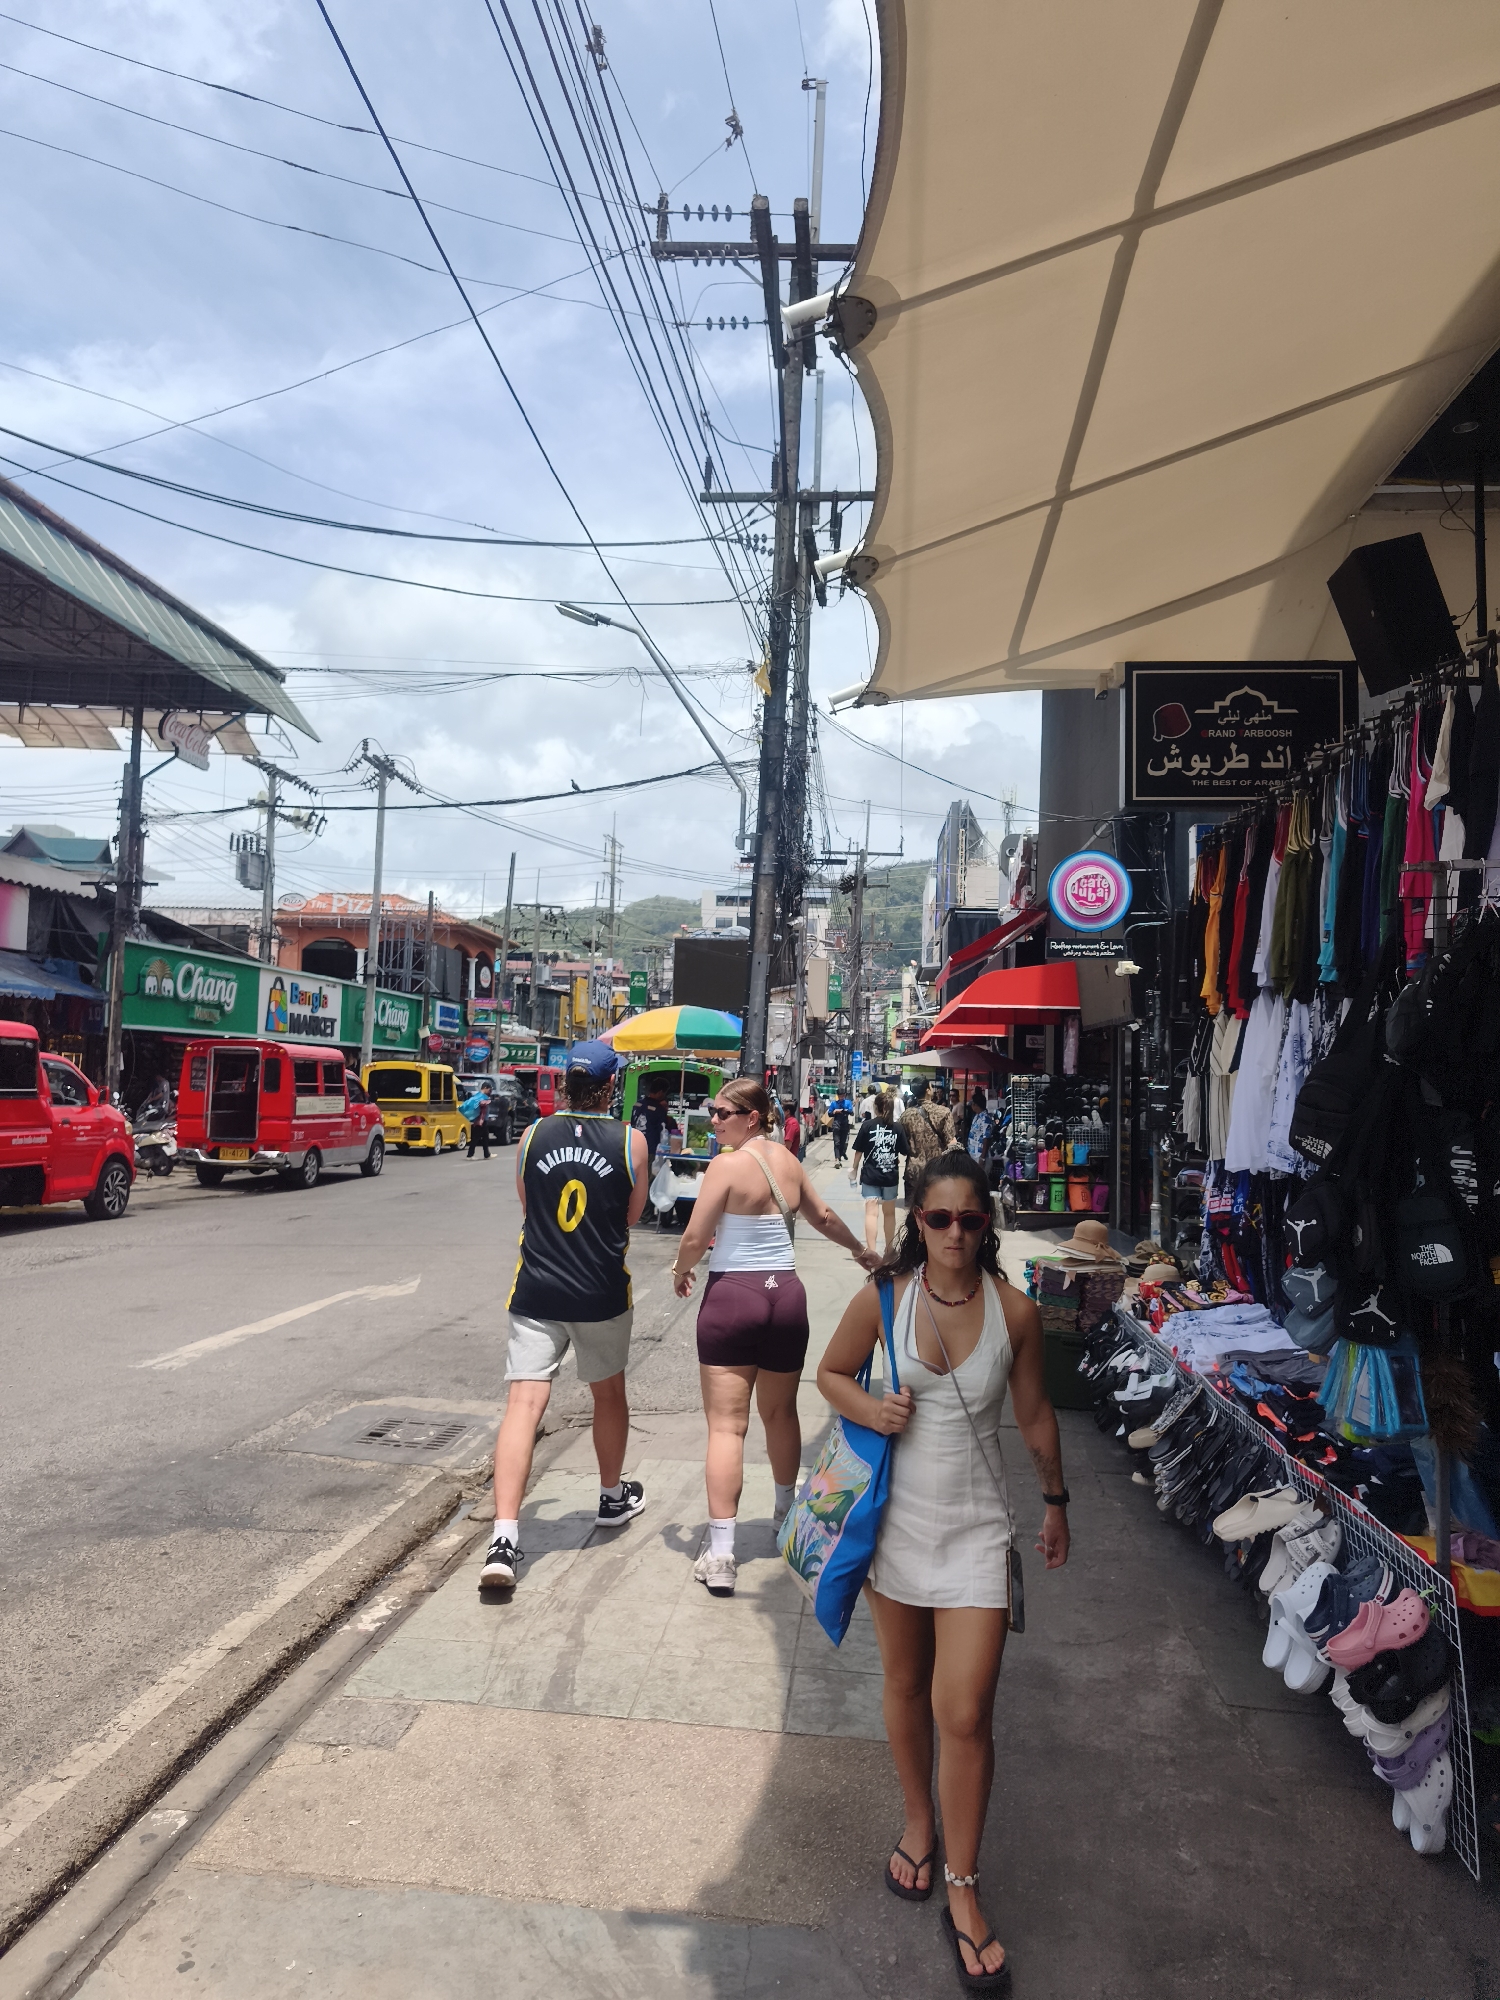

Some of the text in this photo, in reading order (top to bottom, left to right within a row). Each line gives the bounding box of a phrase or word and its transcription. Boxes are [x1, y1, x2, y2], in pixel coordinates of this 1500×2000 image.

[1218, 709, 1240, 726] ليلي
[1201, 729, 1292, 738] GRAND TARBOOSH
[1147, 741, 1249, 777] طربوش
[1071, 882, 1109, 902] dubai
[310, 900, 328, 909] The
[176, 962, 238, 1013] Chang
[290, 982, 329, 1013] Bangla
[377, 998, 410, 1033] Chang
[289, 1013, 338, 1038] MARKET
[511, 1049, 537, 1057] 1112
[1307, 1135, 1325, 1145] THE
[536, 1146, 614, 1178] HALIBURTON
[557, 1178, 588, 1233] 0
[1410, 1250, 1437, 1261] NORTH
[1419, 1243, 1435, 1252] THE
[1419, 1257, 1439, 1266] FACE
